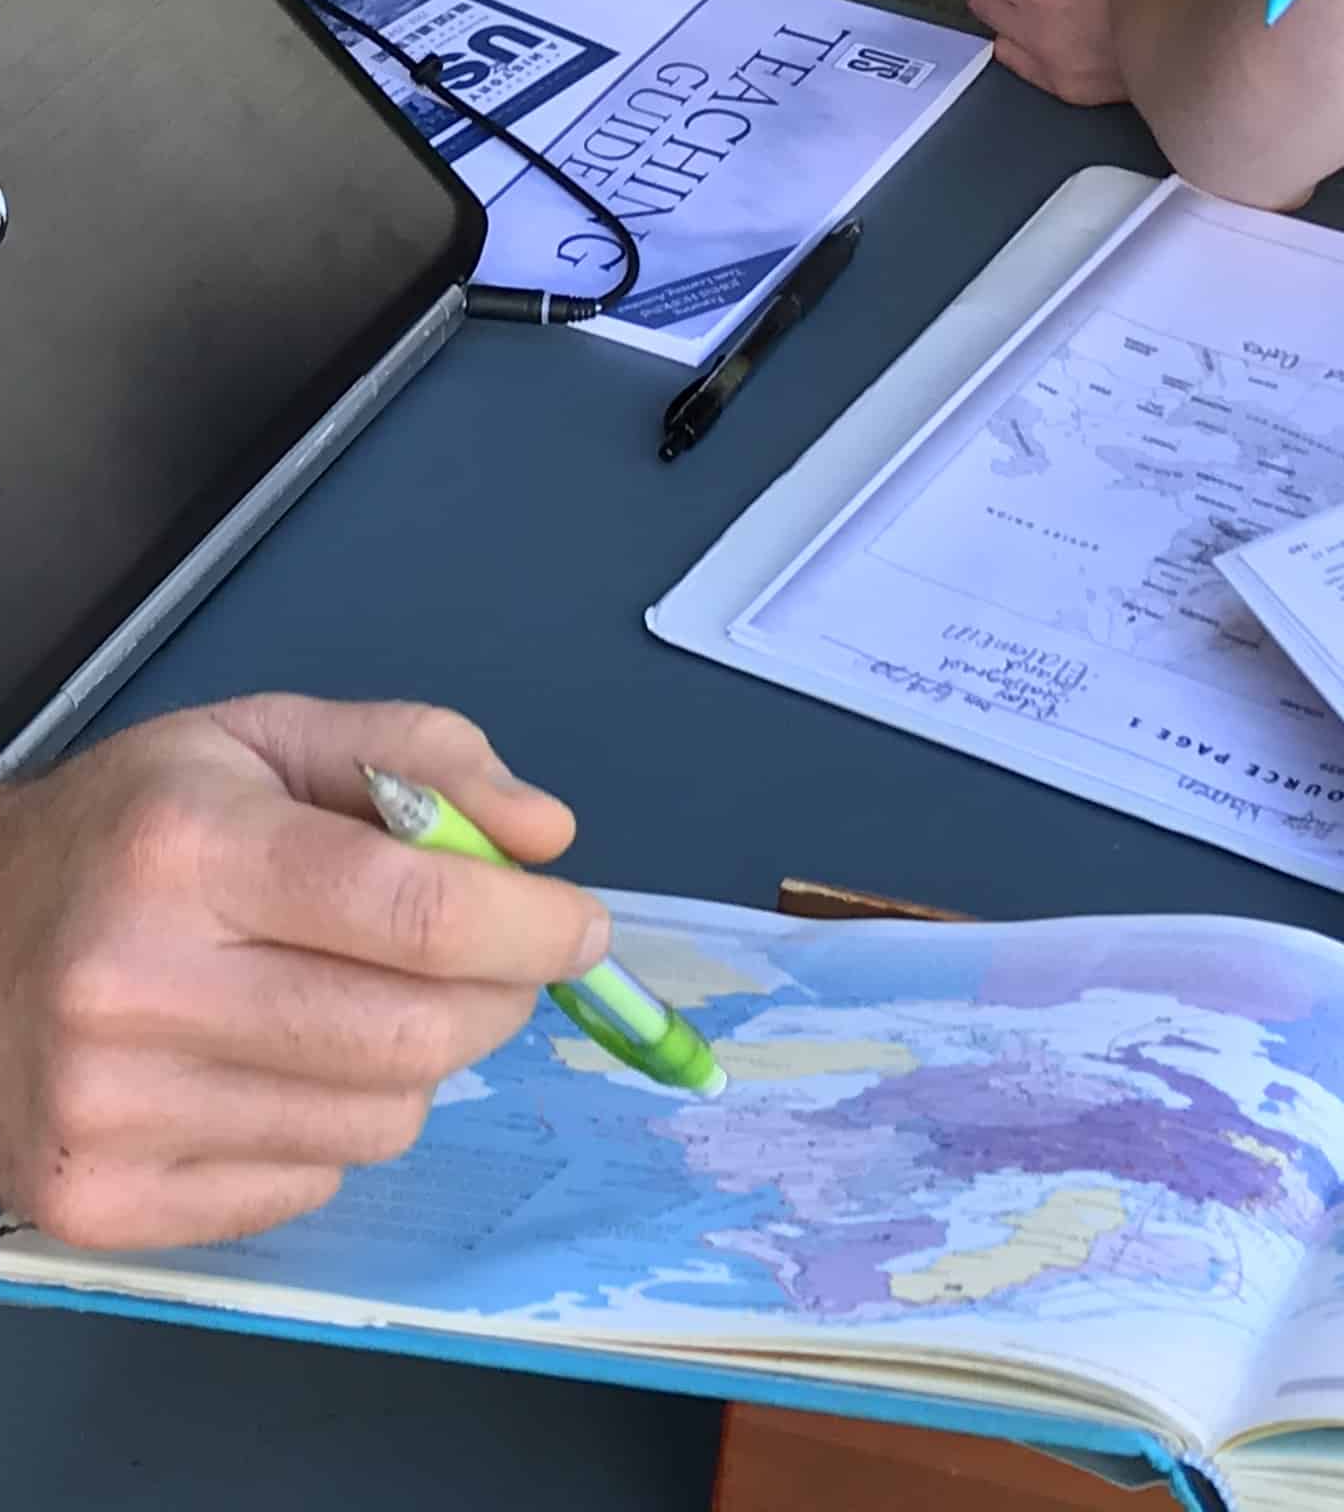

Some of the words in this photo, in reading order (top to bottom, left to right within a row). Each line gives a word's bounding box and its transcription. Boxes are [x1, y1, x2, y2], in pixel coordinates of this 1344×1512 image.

[439, 24, 546, 90] US
[466, 52, 546, 103] HISTORY
[847, 46, 910, 80] US
[556, 23, 852, 272] TEACHING
[558, 61, 709, 187] GUIDE
[1157, 727, 1231, 765] PAGE
